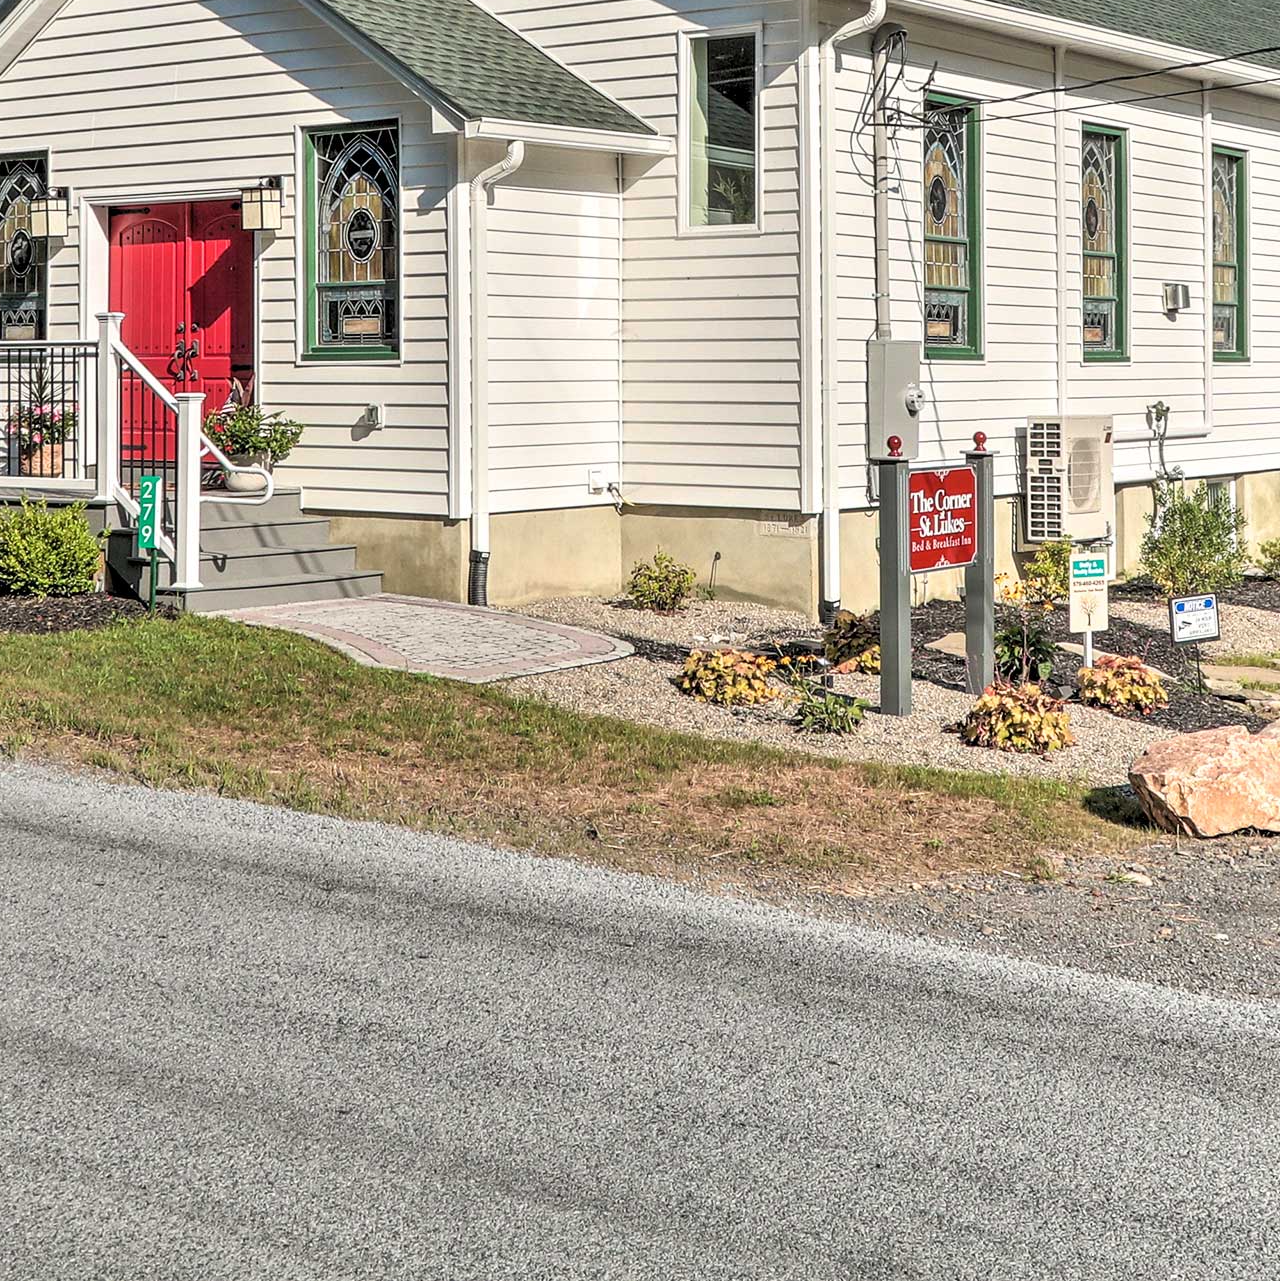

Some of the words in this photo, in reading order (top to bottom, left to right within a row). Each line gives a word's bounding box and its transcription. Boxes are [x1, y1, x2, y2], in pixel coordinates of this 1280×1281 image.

[141, 481, 153, 543] 279
[910, 489, 934, 513] The
[934, 489, 972, 511] Corner
[933, 511, 965, 535] Lukes
[912, 540, 924, 552] Bed
[925, 540, 931, 550] &
[932, 536, 960, 550] Breakfast
[961, 535, 972, 545] Inn
[1184, 599, 1206, 613] NOTICE
